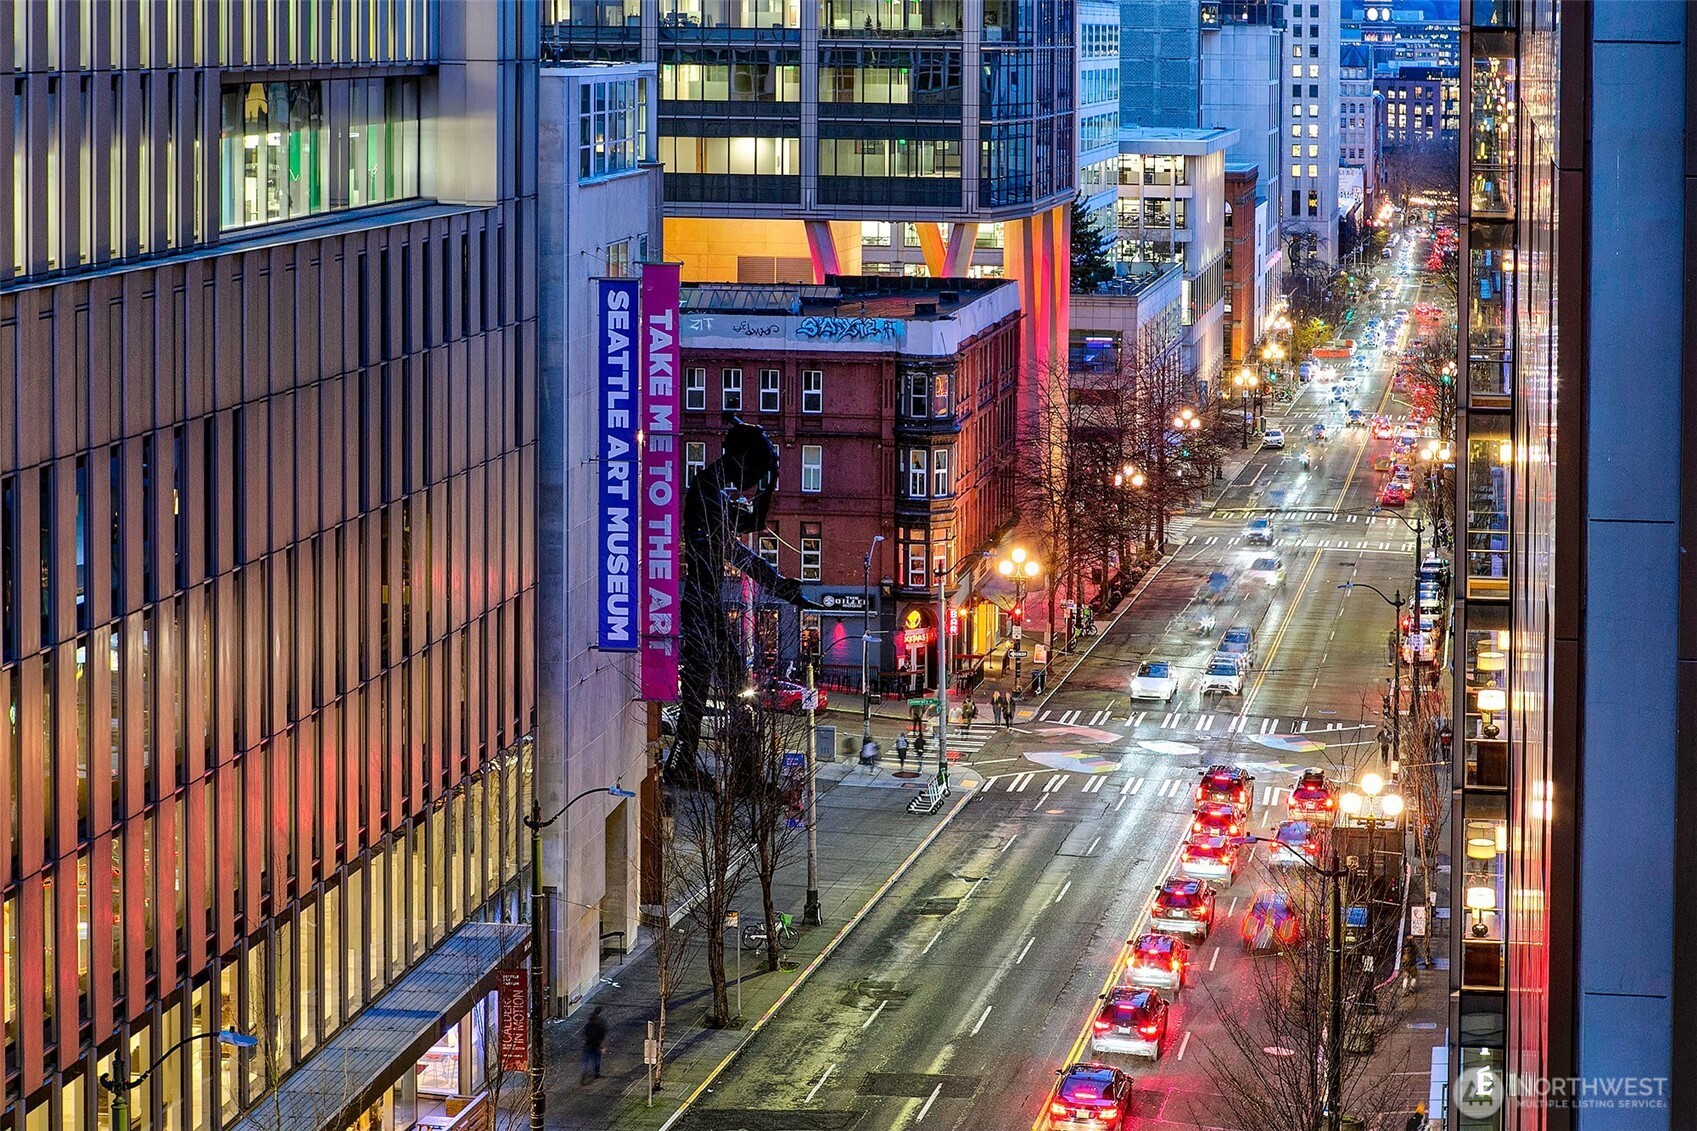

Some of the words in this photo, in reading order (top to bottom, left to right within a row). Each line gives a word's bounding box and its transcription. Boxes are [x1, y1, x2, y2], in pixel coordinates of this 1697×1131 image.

[607, 290, 630, 428] SEATTLE
[649, 309, 673, 396] TAKE
[649, 405, 673, 452] ME
[607, 435, 630, 500] ART
[649, 461, 673, 506] TO
[607, 507, 630, 641] MUSEUM
[648, 514, 672, 579] THE
[648, 587, 672, 656] ART
[950, 610, 958, 634] BAR
[512, 990, 524, 1031] MOTION
